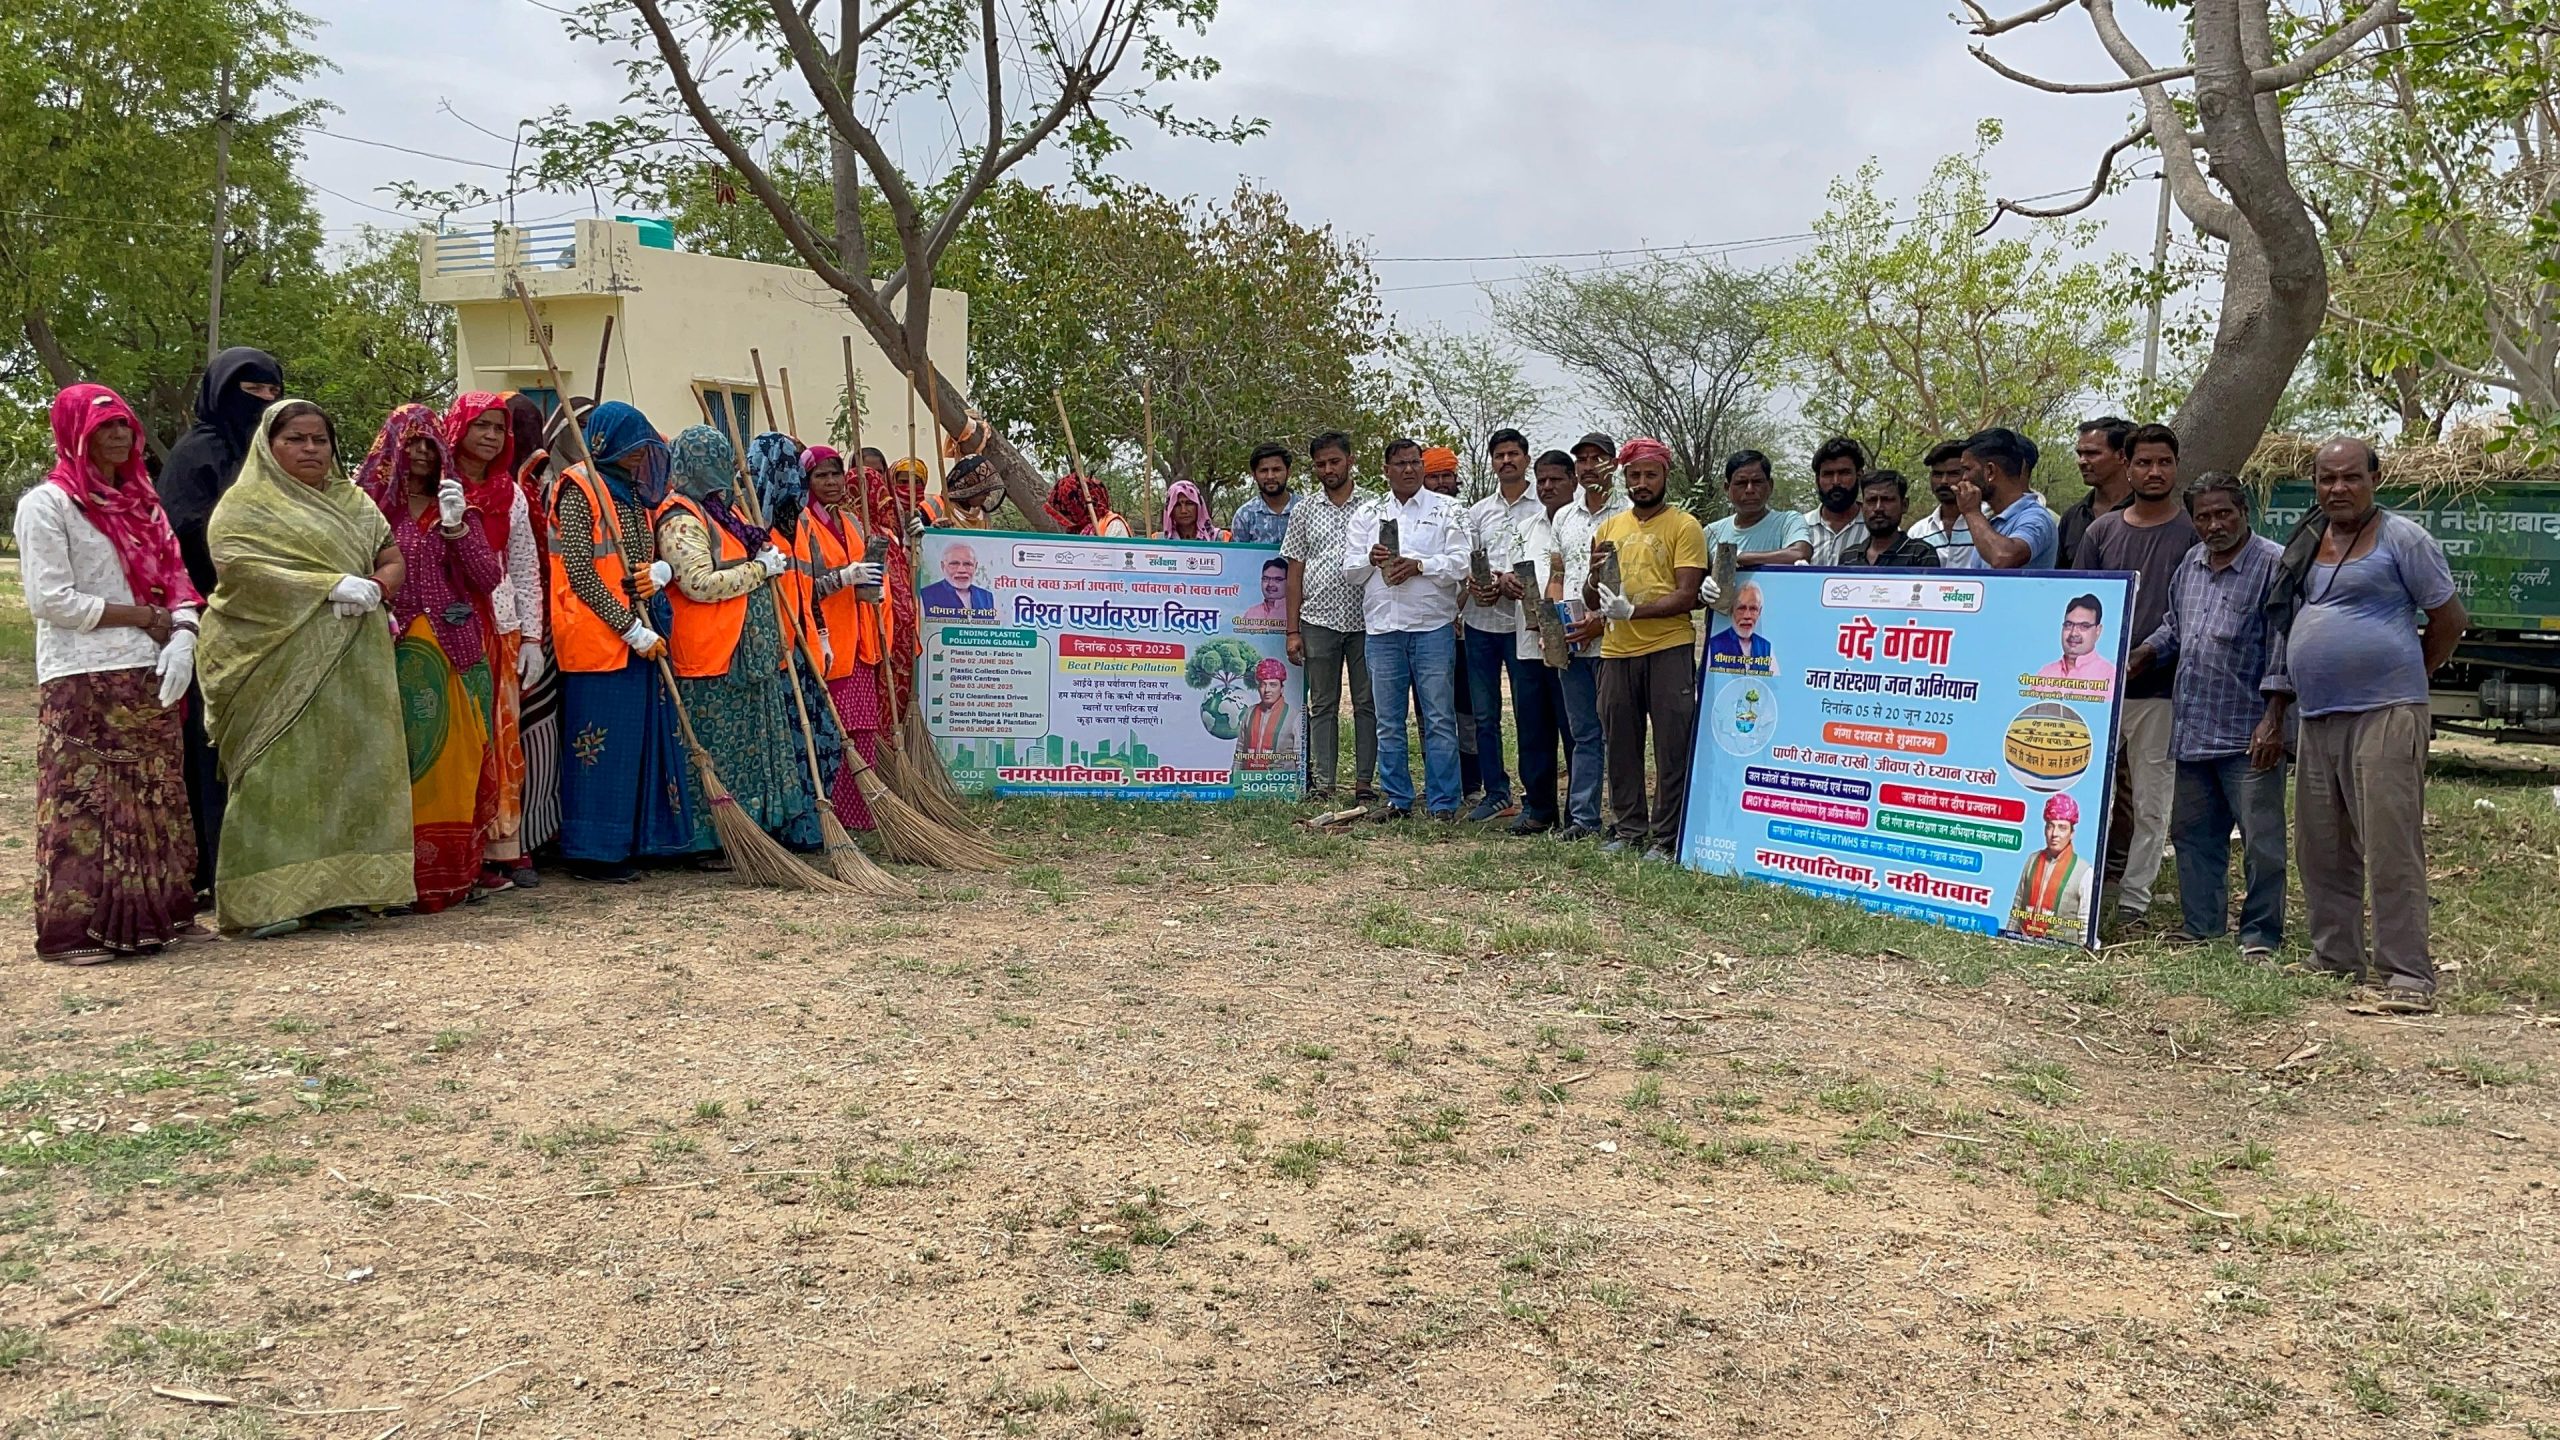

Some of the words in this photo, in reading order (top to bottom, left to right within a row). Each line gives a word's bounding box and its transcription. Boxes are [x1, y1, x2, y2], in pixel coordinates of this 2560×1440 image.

[994, 575, 1016, 589] हरित
[1020, 576, 1034, 589] एवं
[1038, 579, 1061, 590] स्वच्छ
[1063, 578, 1085, 591] ऊर्जा
[1132, 581, 1171, 594] पर्यावरण
[1173, 582, 1187, 594] को
[1190, 585, 1212, 596] स्वच्छ
[1942, 589, 1975, 602] सर्वेक्षण
[1014, 596, 1064, 627] विश्व
[1068, 600, 1159, 631] पर्यावरण
[1163, 602, 1220, 634] दिवस
[1073, 639, 1107, 653] दिनांक
[1109, 644, 1122, 653] 05
[1125, 643, 1143, 657] जून
[1145, 644, 1172, 655] 2025
[1838, 616, 1878, 662] वंदे
[1883, 619, 1953, 665] गंगा
[1067, 660, 1092, 670] Beat
[1094, 661, 1129, 672] Plastic
[1130, 662, 1177, 673] Pollution
[1094, 680, 1105, 688] इस
[1106, 679, 1137, 688] पर्यावरण
[1138, 680, 1158, 690] दिवस
[1806, 670, 1831, 689] जल
[1833, 668, 1882, 693] संरक्षण
[1884, 676, 1913, 696] जन
[1915, 673, 1979, 701] अभियान
[1058, 691, 1069, 700] हम
[1070, 690, 1094, 700] संकल्प
[1104, 691, 1115, 700] कि
[1117, 690, 1134, 700] कभी
[1136, 691, 1146, 700] भी
[1147, 691, 1182, 701] सार्वजनिक
[1147, 704, 1159, 714] एवं
[1822, 698, 1853, 716] दिनांक
[1855, 706, 1869, 718] 05
[1873, 702, 1883, 718] से
[1885, 708, 1900, 720] 20
[1903, 708, 1921, 726] जून
[1924, 711, 1954, 725] 2025
[1834, 725, 1852, 740] गंगा
[1854, 729, 1883, 743] दशहरा
[1885, 728, 1895, 744] से
[1896, 732, 1937, 750] शुभारम्भ
[952, 770, 986, 779] CODE
[1773, 746, 1798, 760] पाणी
[1800, 747, 1812, 762] रो
[1814, 750, 1837, 765] मान
[1874, 756, 1910, 774] जीवण
[1912, 760, 1926, 776] रो
[1964, 768, 1998, 785] राखो
[998, 765, 1129, 785] नगरपालिका,
[1135, 766, 1230, 785] नसीराबाद
[1241, 773, 1262, 781] ULB
[1265, 773, 1297, 782] CODE
[1748, 770, 1760, 782] जल
[1780, 772, 1790, 786] की
[1830, 780, 1842, 795] एवं
[1242, 782, 1296, 793] 800573
[1902, 791, 1916, 804] जल
[1939, 796, 1948, 806] पर
[1950, 796, 1965, 810] दीप
[1694, 834, 1712, 846] ULB
[1713, 838, 1738, 851] CODE
[1830, 834, 1859, 849] RTWHS
[1756, 849, 1880, 890] नगरपालिका,
[1886, 870, 1991, 906] नसीराबाद
